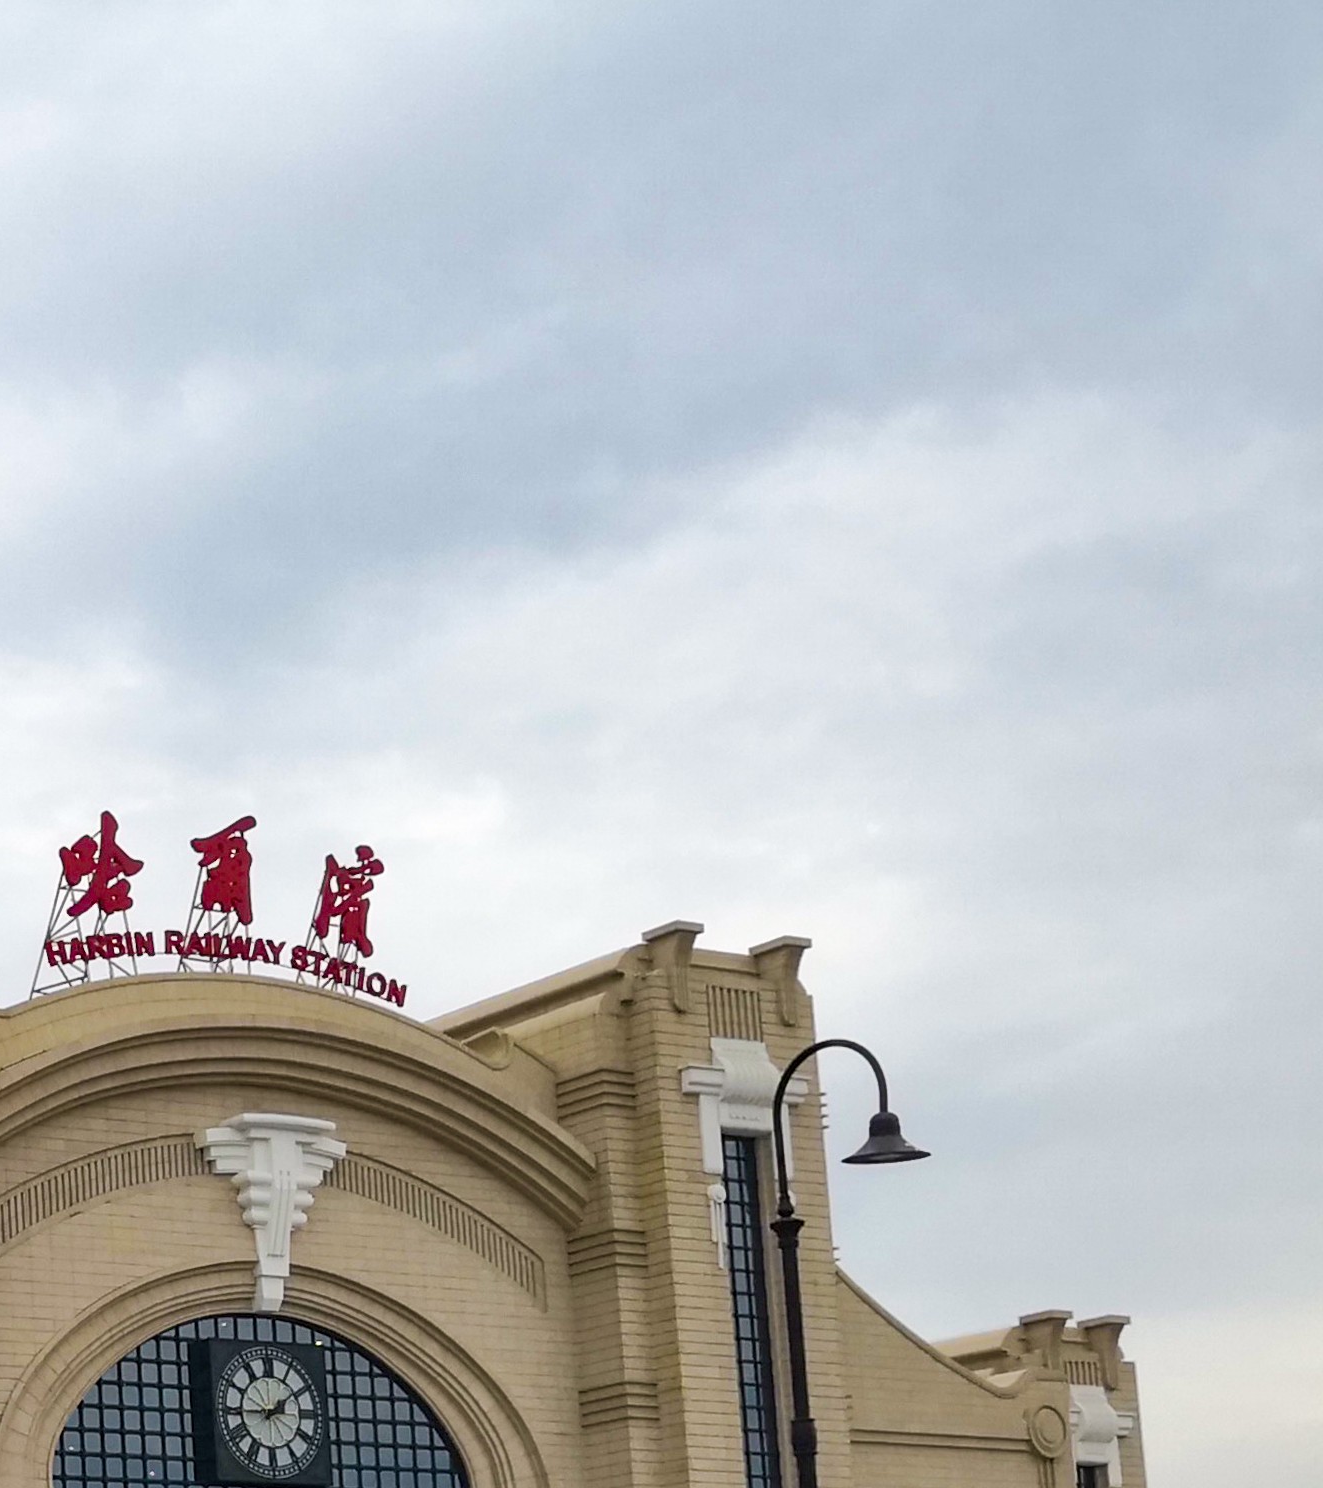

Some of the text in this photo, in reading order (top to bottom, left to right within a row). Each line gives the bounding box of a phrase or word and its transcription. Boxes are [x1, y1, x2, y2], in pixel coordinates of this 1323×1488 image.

[45, 930, 408, 1008] HARBIN RAILWAY STATION
